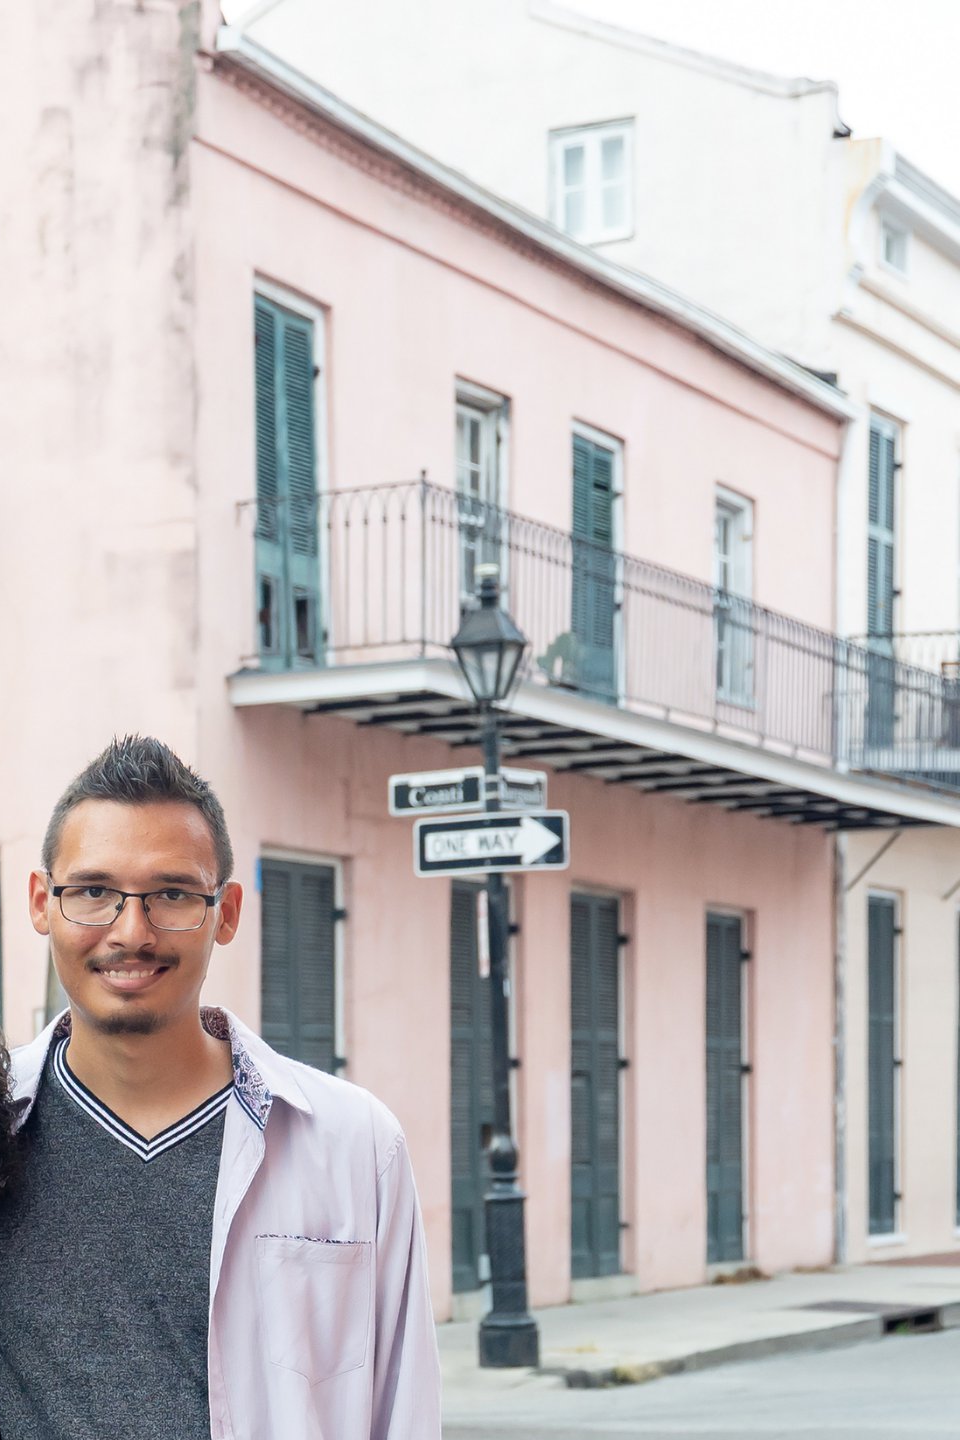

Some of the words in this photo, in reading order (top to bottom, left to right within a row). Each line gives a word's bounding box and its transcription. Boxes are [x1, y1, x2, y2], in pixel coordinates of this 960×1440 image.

[408, 784, 464, 807] Conti
[432, 835, 468, 856] ONE
[477, 831, 518, 852] WAY
